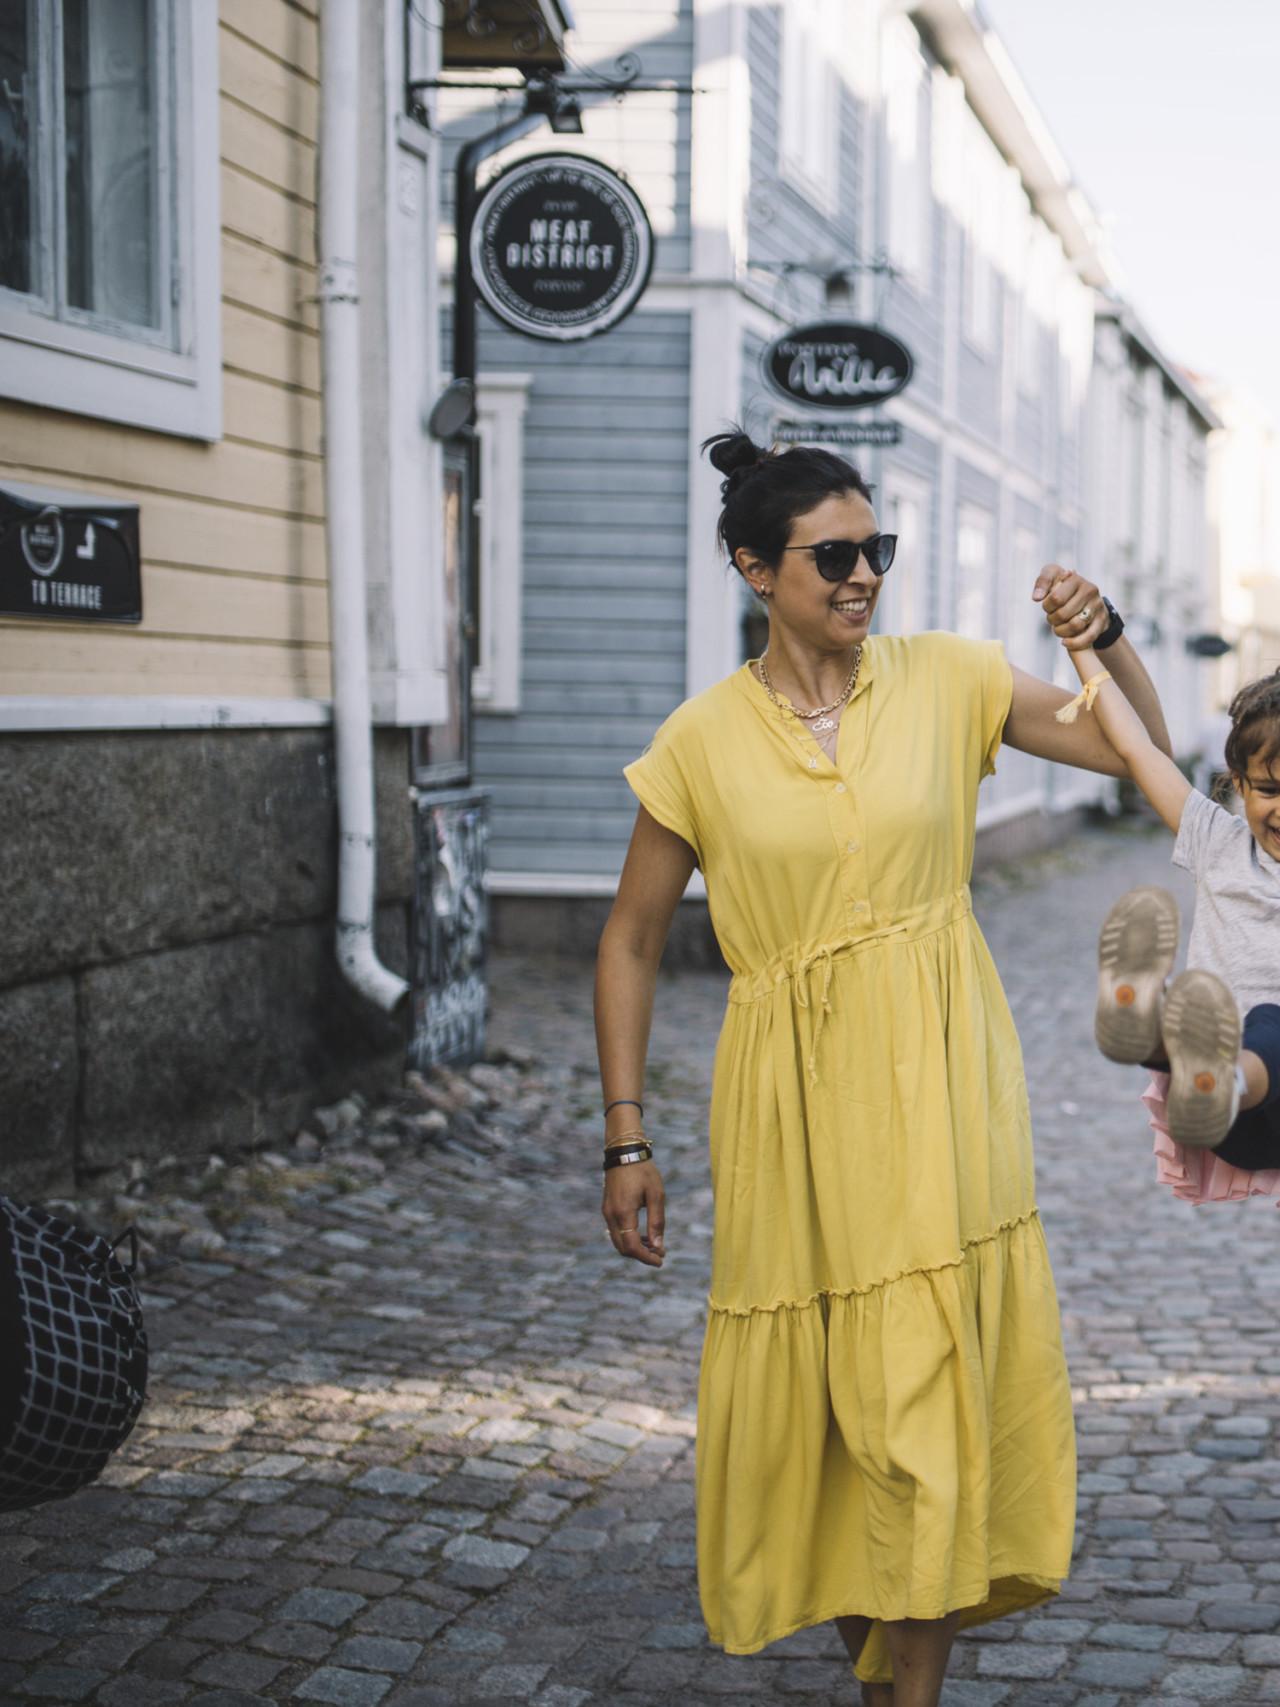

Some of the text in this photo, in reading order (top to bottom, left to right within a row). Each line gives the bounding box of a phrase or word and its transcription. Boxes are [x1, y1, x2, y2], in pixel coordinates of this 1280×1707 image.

[530, 218, 592, 243] MEAT
[506, 242, 615, 271] DISTRICT
[32, 580, 102, 609] TO TERRACE
